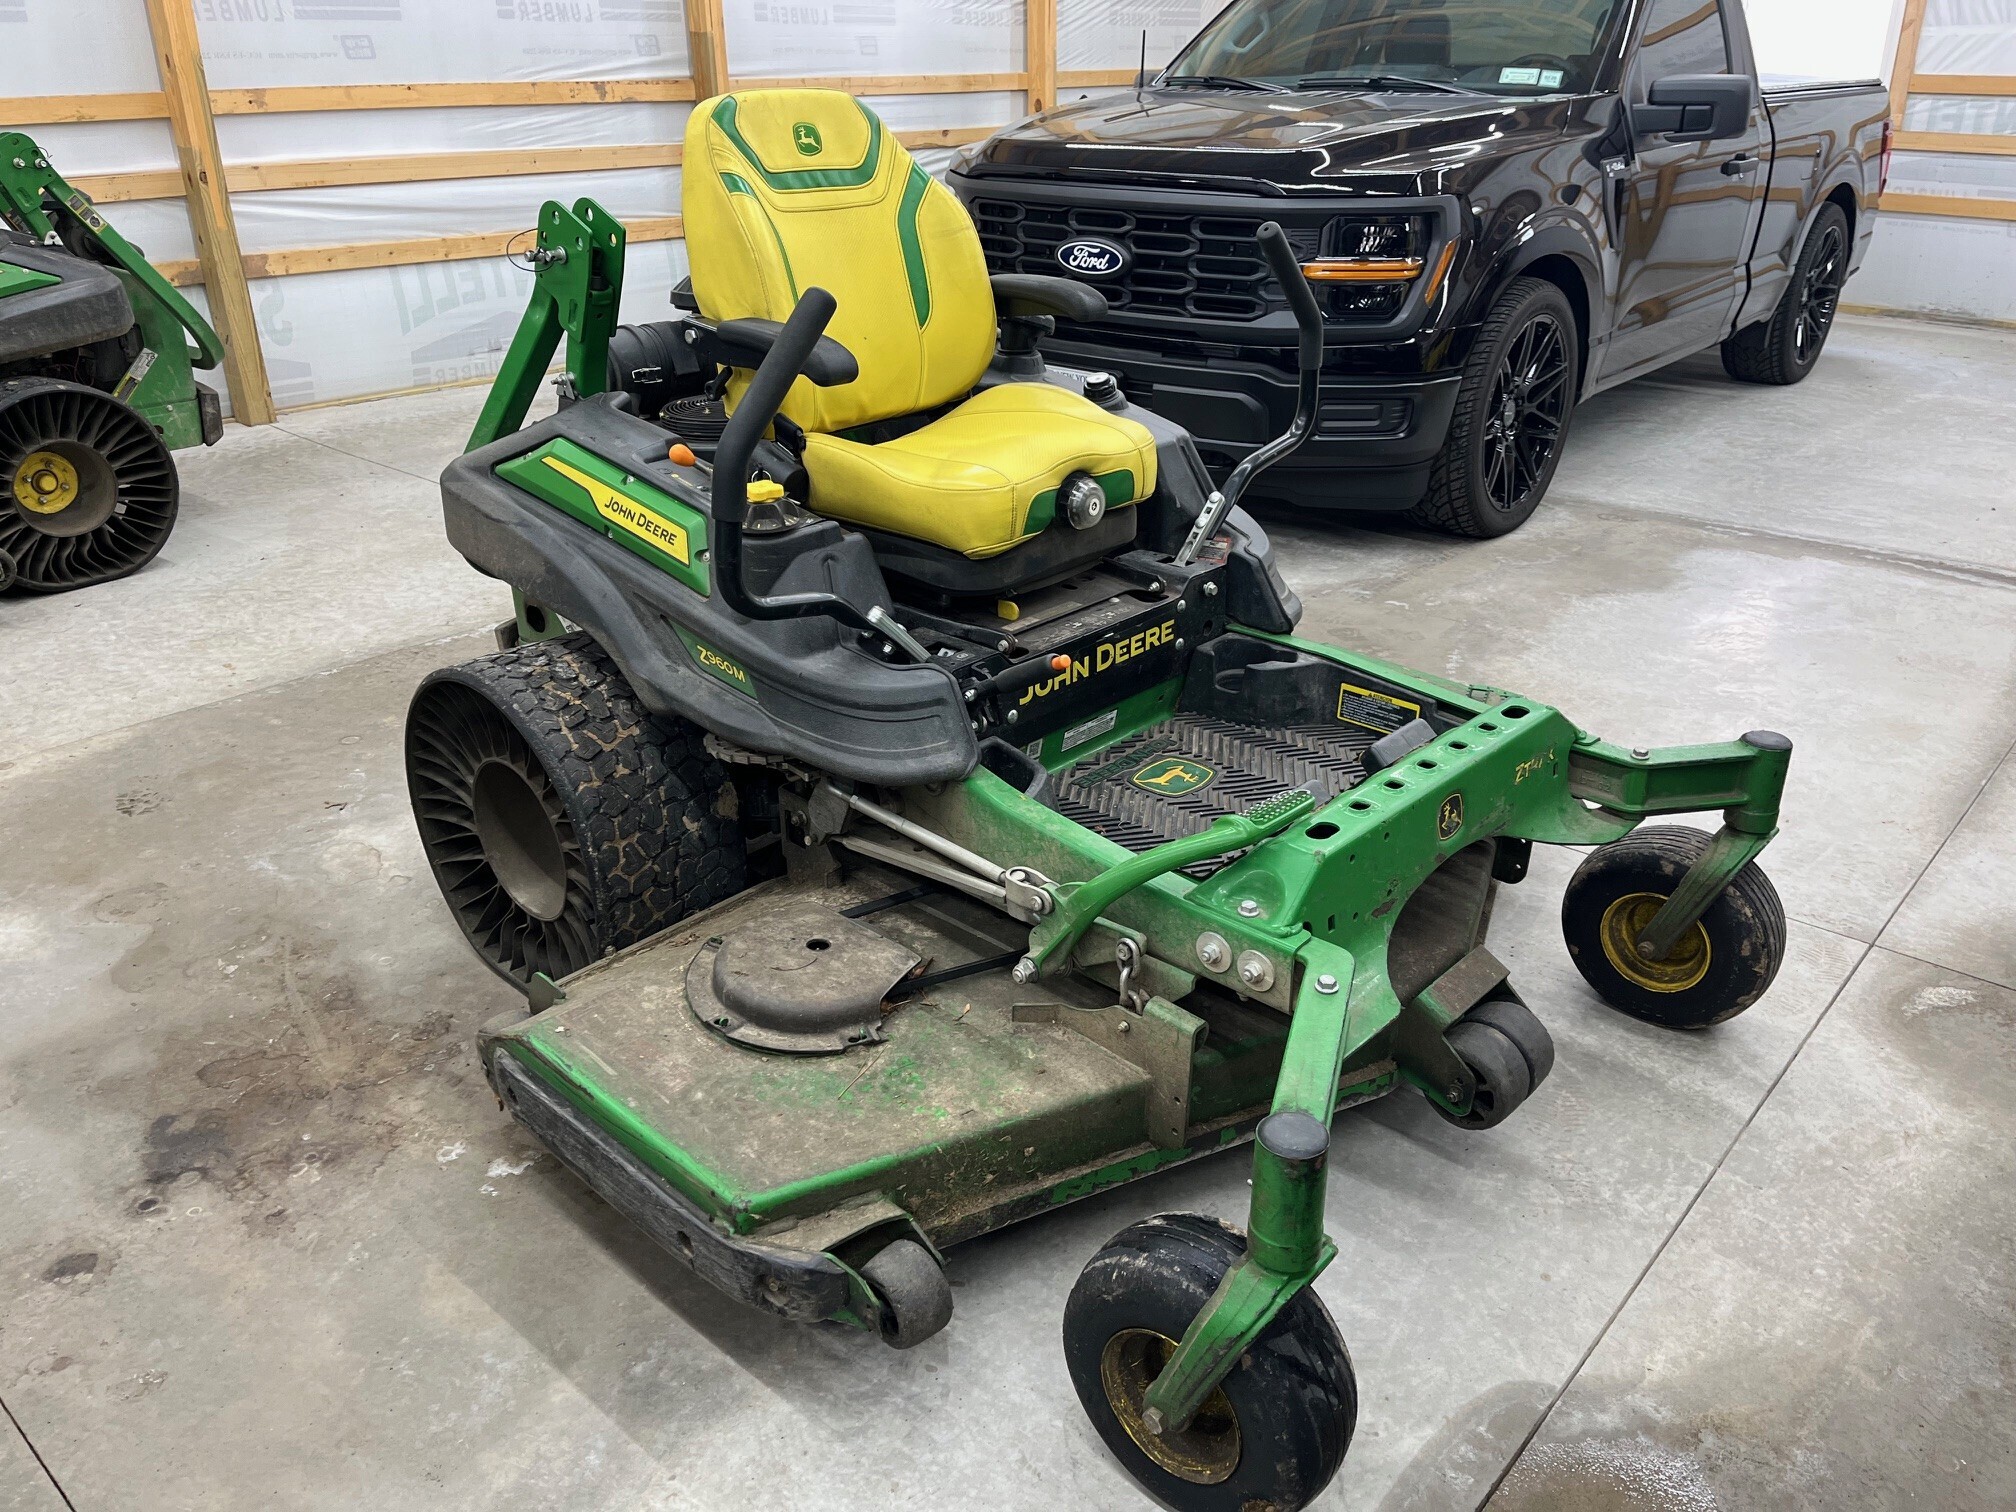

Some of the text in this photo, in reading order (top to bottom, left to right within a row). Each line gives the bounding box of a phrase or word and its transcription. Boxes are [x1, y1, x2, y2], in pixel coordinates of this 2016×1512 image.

[1069, 245, 1110, 270] Ford
[604, 496, 678, 546] JOHN DEERE
[696, 645, 746, 683] Z960M
[1096, 618, 1175, 673] DEERE
